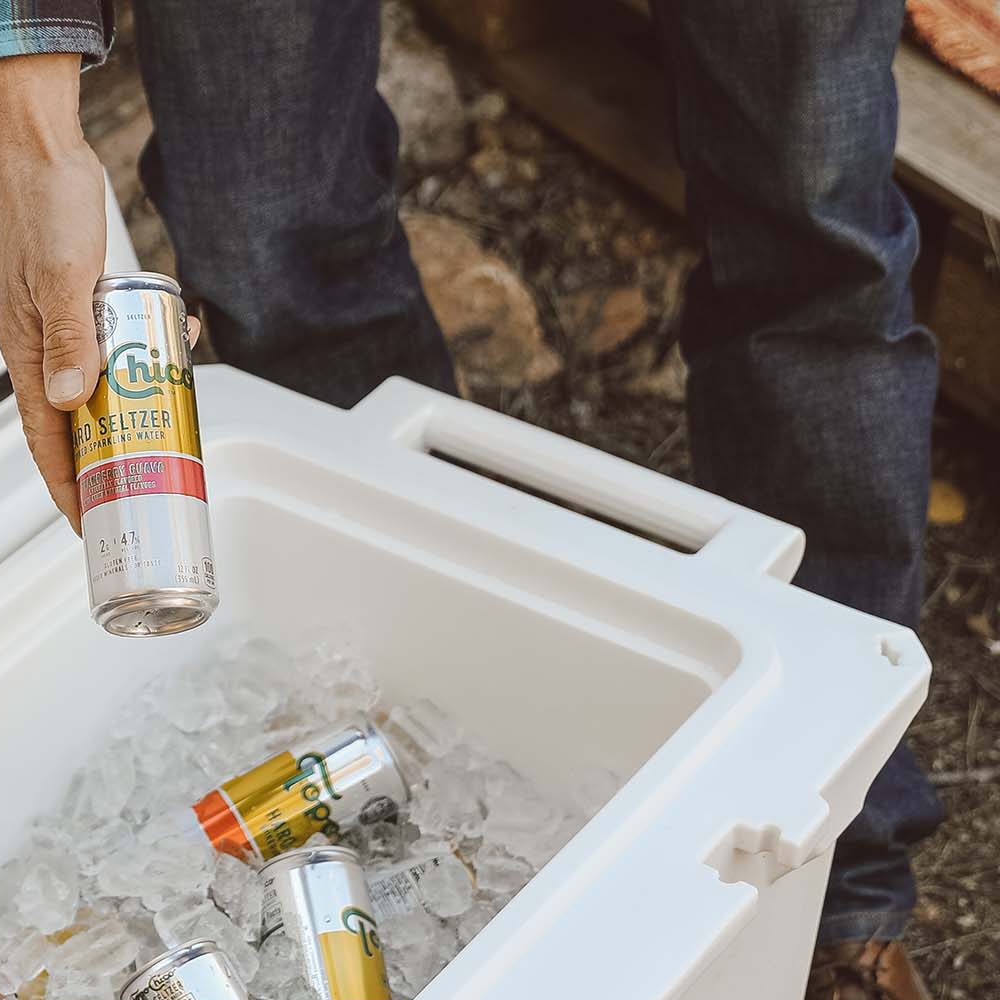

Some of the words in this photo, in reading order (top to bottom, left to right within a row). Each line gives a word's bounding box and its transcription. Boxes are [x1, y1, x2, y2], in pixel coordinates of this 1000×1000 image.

[106, 342, 193, 399] Chico
[73, 423, 92, 449] ARD
[98, 410, 172, 436] SELTZER
[89, 433, 132, 452] SPARKLING
[136, 431, 166, 441] WATER
[129, 461, 165, 474] GUAVA
[149, 970, 176, 992] Chico
